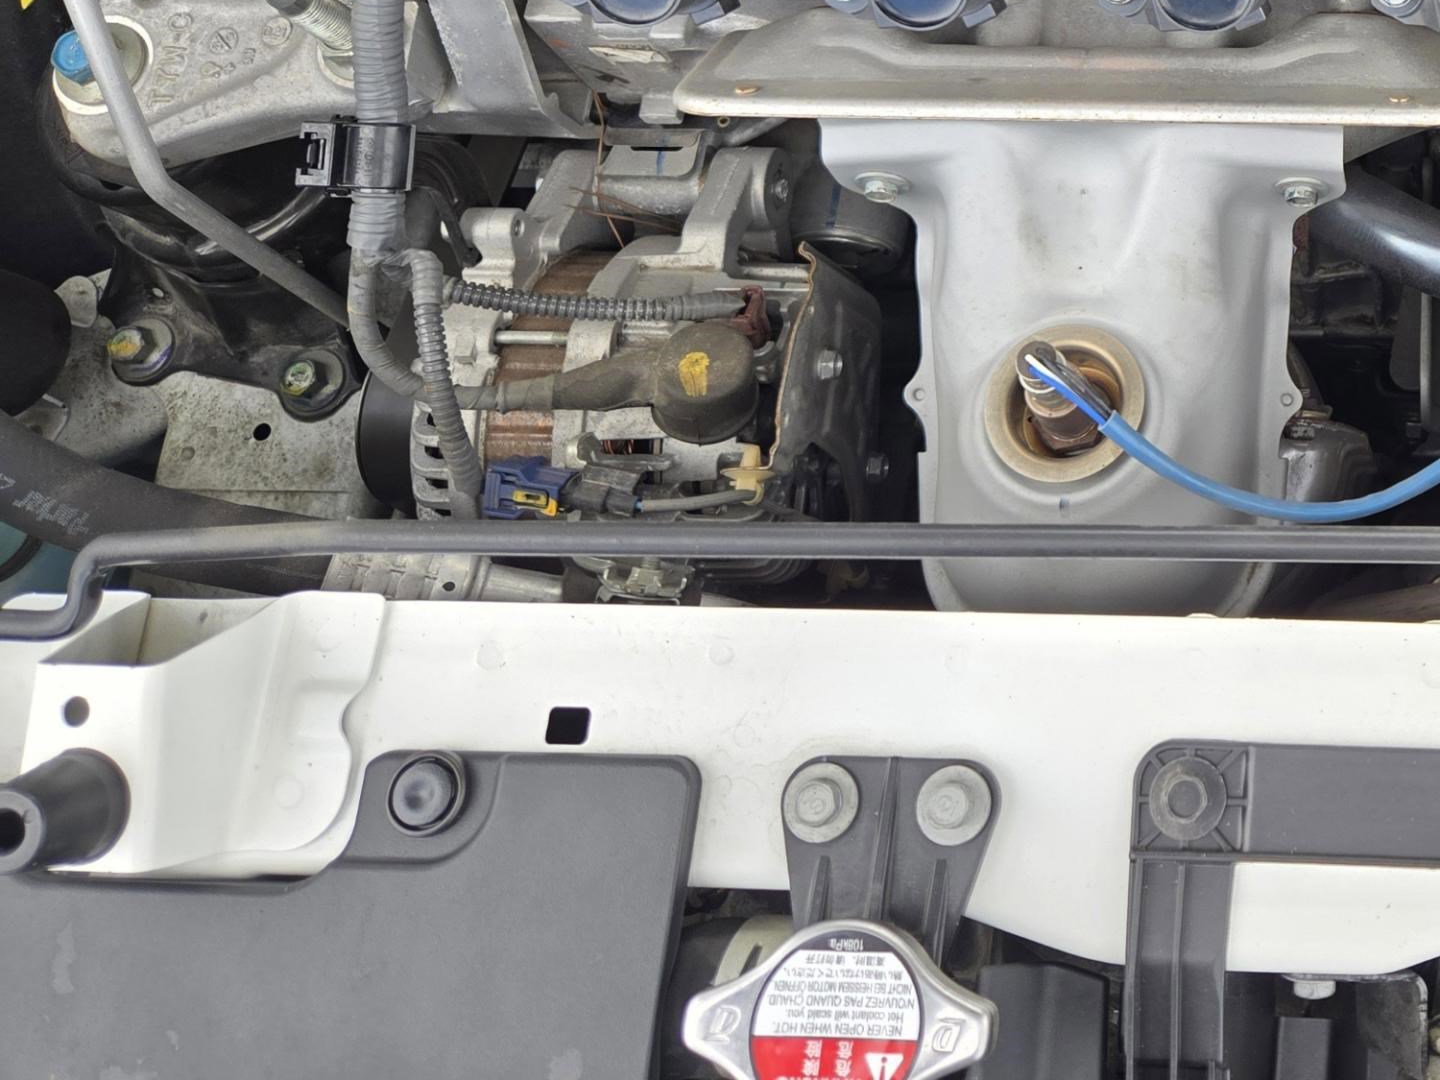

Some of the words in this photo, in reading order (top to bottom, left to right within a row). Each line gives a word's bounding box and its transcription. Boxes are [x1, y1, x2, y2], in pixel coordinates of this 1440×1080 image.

[830, 939, 864, 951] 108kPa
[808, 981, 836, 992] MOTOR
[889, 983, 912, 994] NICHT
[806, 995, 842, 1006] QUAND
[844, 996, 864, 1007] PAS
[808, 1010, 832, 1020] scald
[834, 1011, 849, 1021] will
[852, 1011, 885, 1022] coolant
[888, 1012, 904, 1023] Hot
[800, 1022, 832, 1035] WHEN
[835, 1023, 864, 1035] OPEN
[868, 1024, 902, 1036] NEVER
